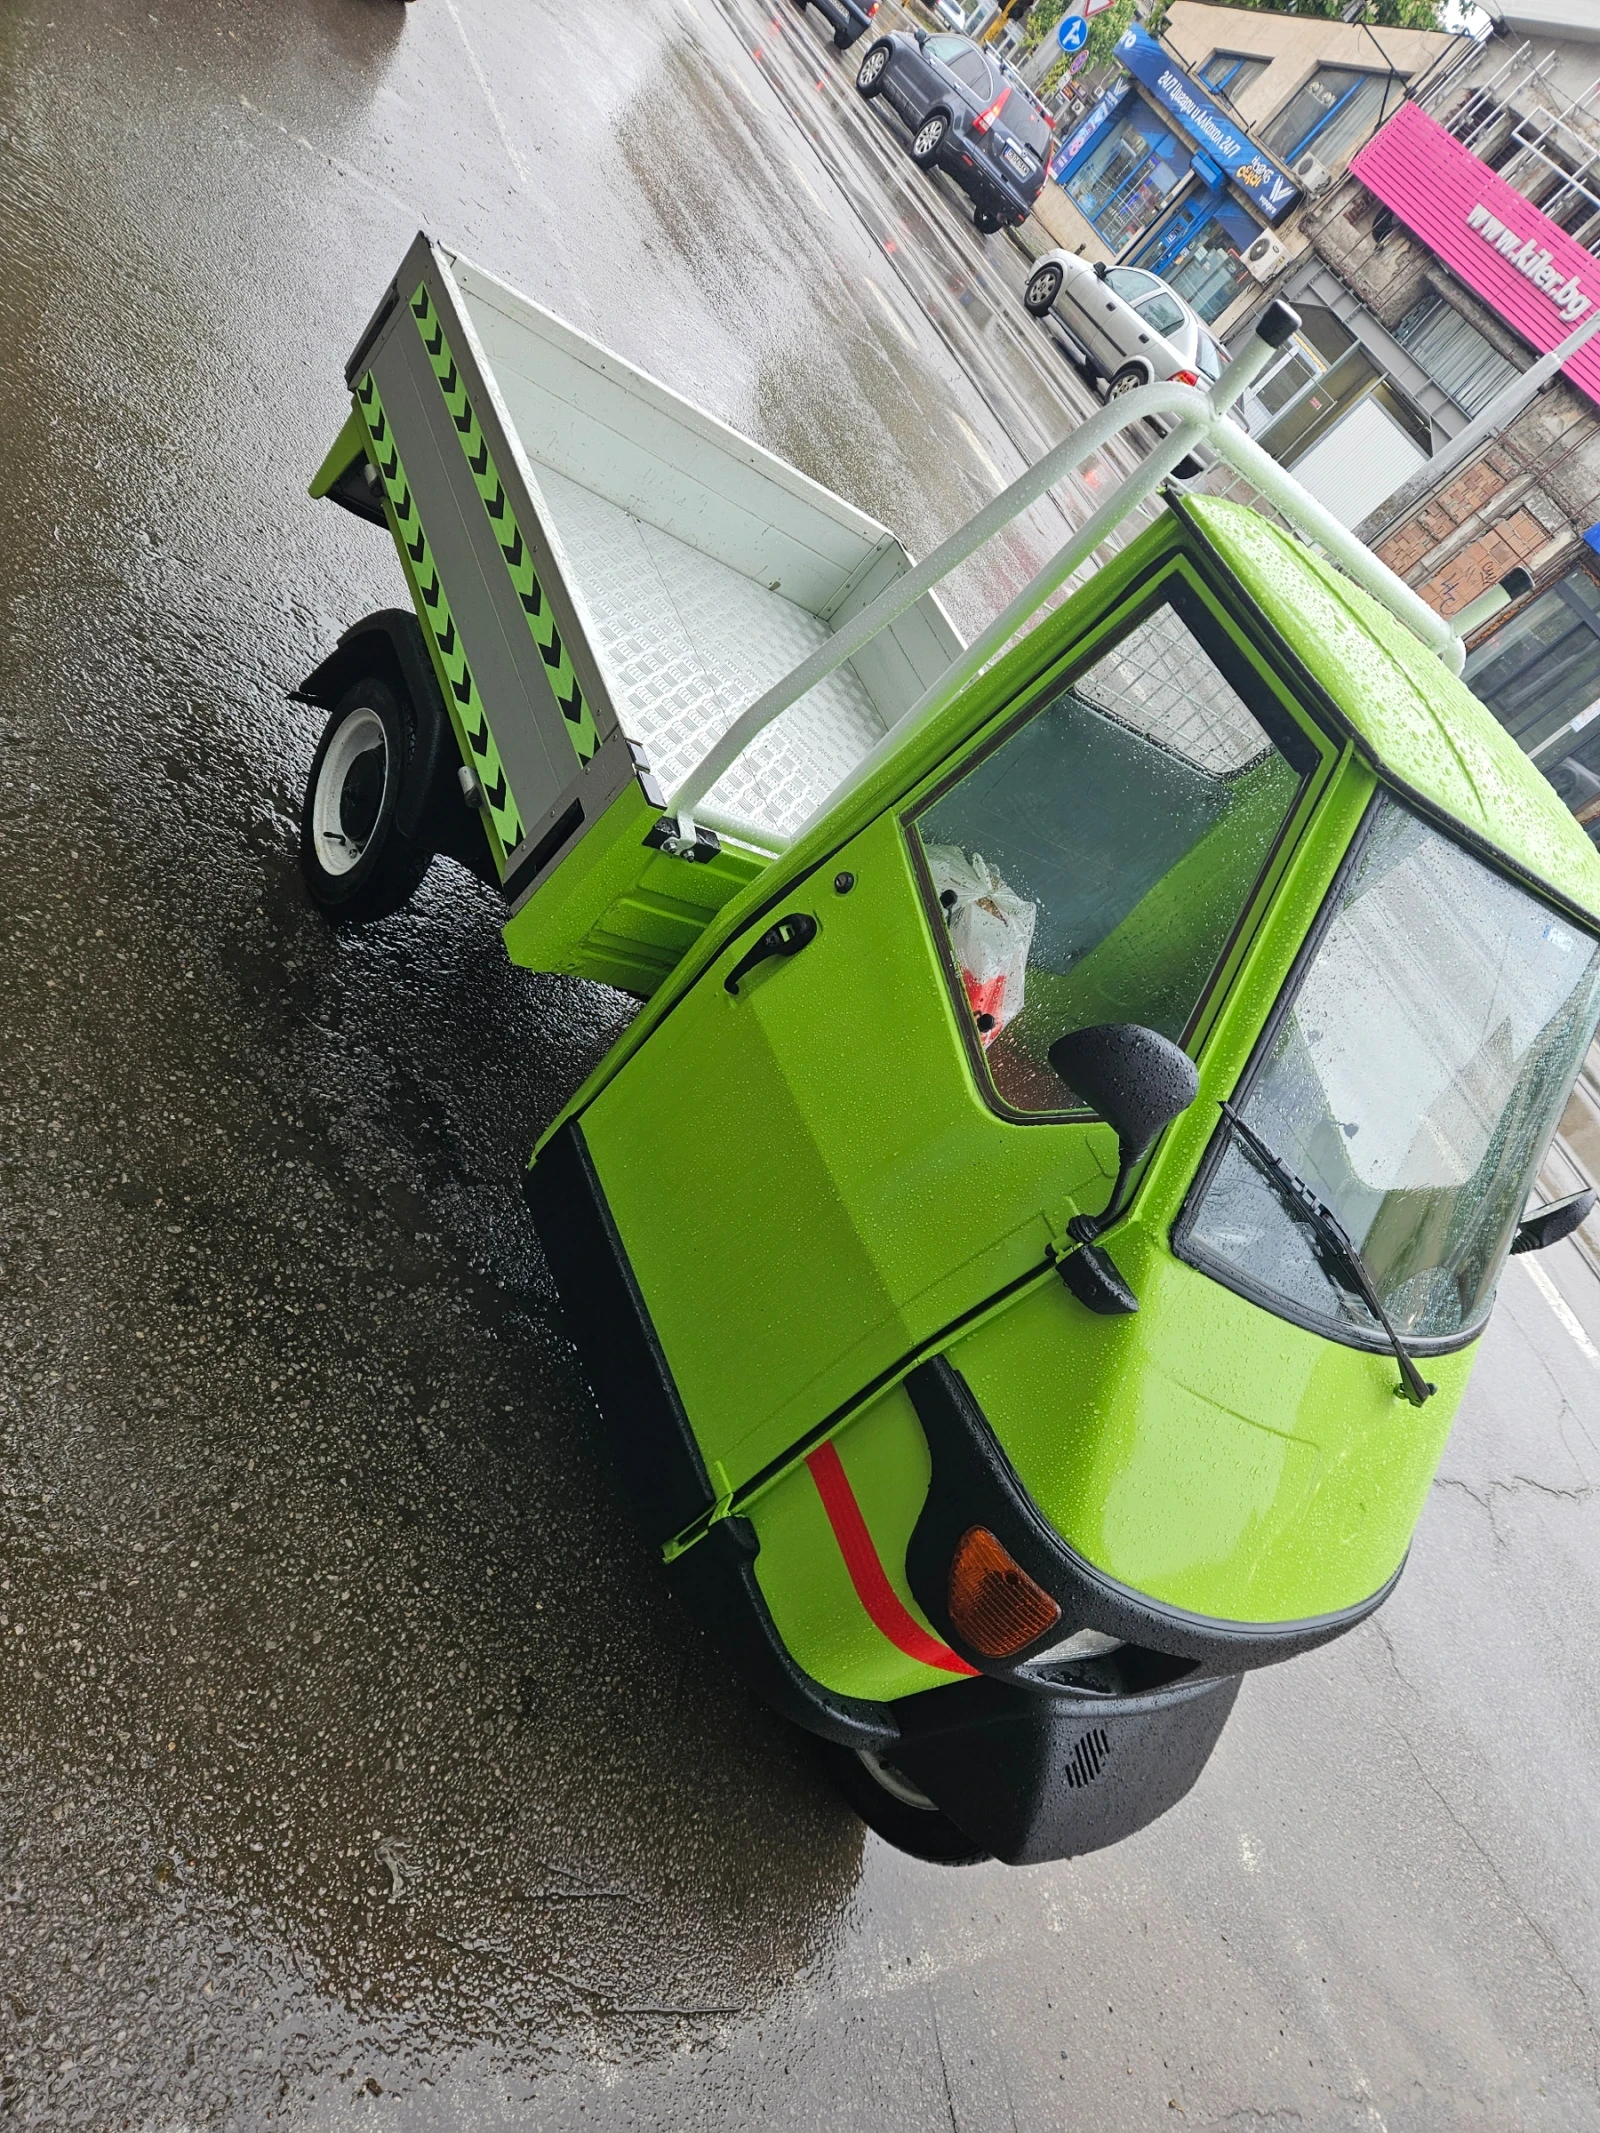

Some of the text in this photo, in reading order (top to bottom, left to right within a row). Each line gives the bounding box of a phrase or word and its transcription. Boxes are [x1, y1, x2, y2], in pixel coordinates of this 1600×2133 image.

[1157, 70, 1241, 159] 24/7 Цигари и Алкохол 24/7
[1466, 202, 1593, 323] www.kiler.bg
